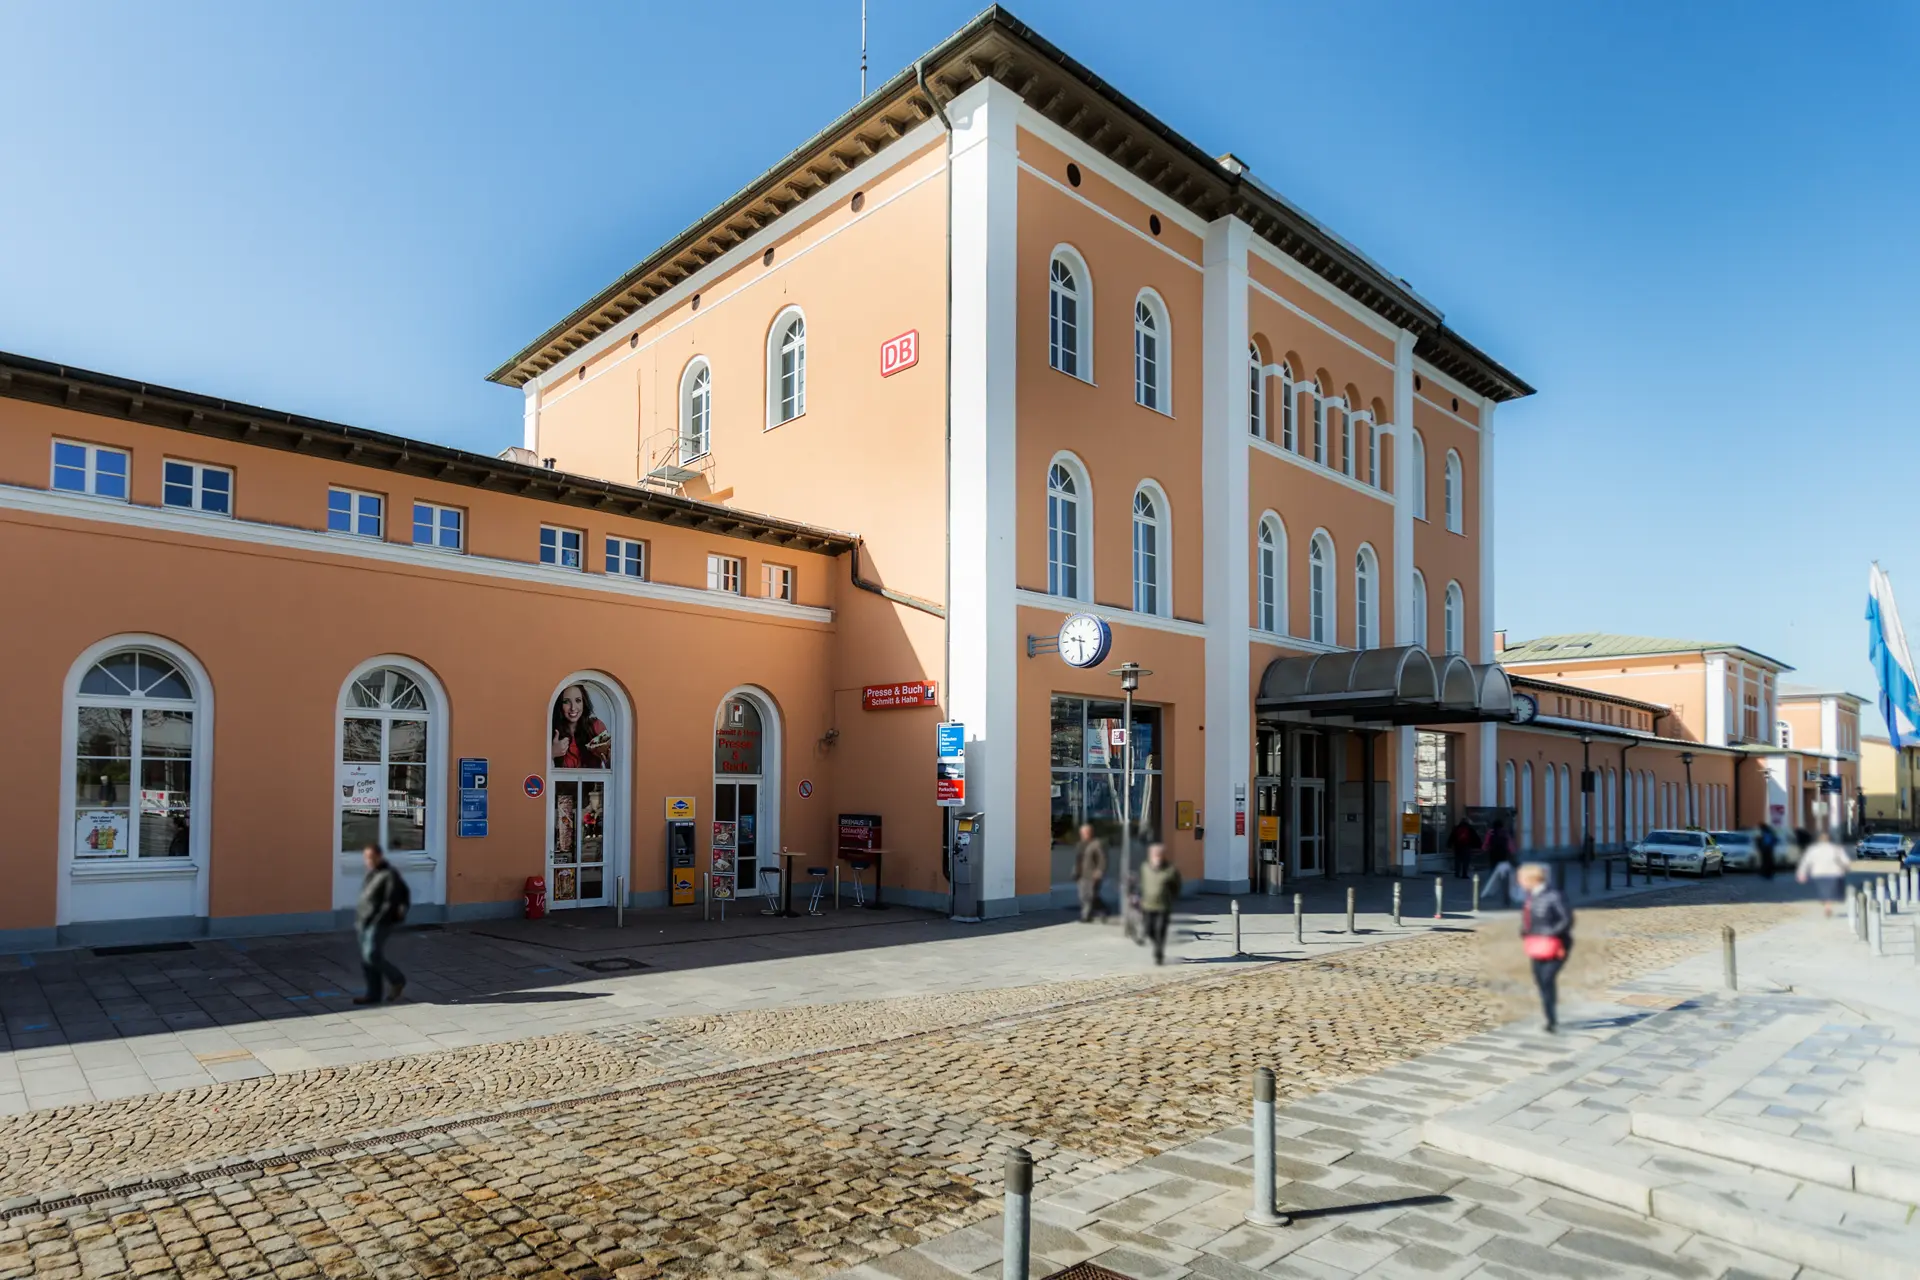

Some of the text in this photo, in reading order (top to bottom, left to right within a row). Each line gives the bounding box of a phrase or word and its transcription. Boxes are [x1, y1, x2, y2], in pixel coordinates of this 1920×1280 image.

[885, 338, 912, 370] DB
[867, 684, 923, 698] Presse & Buch
[871, 695, 918, 706] Schmitt & Hahn
[718, 737, 753, 749] Presse
[722, 760, 749, 772] Buch
[356, 779, 376, 788] Coffee
[474, 775, 486, 789] P
[365, 786, 374, 794] go
[352, 796, 379, 804] 99 Cent
